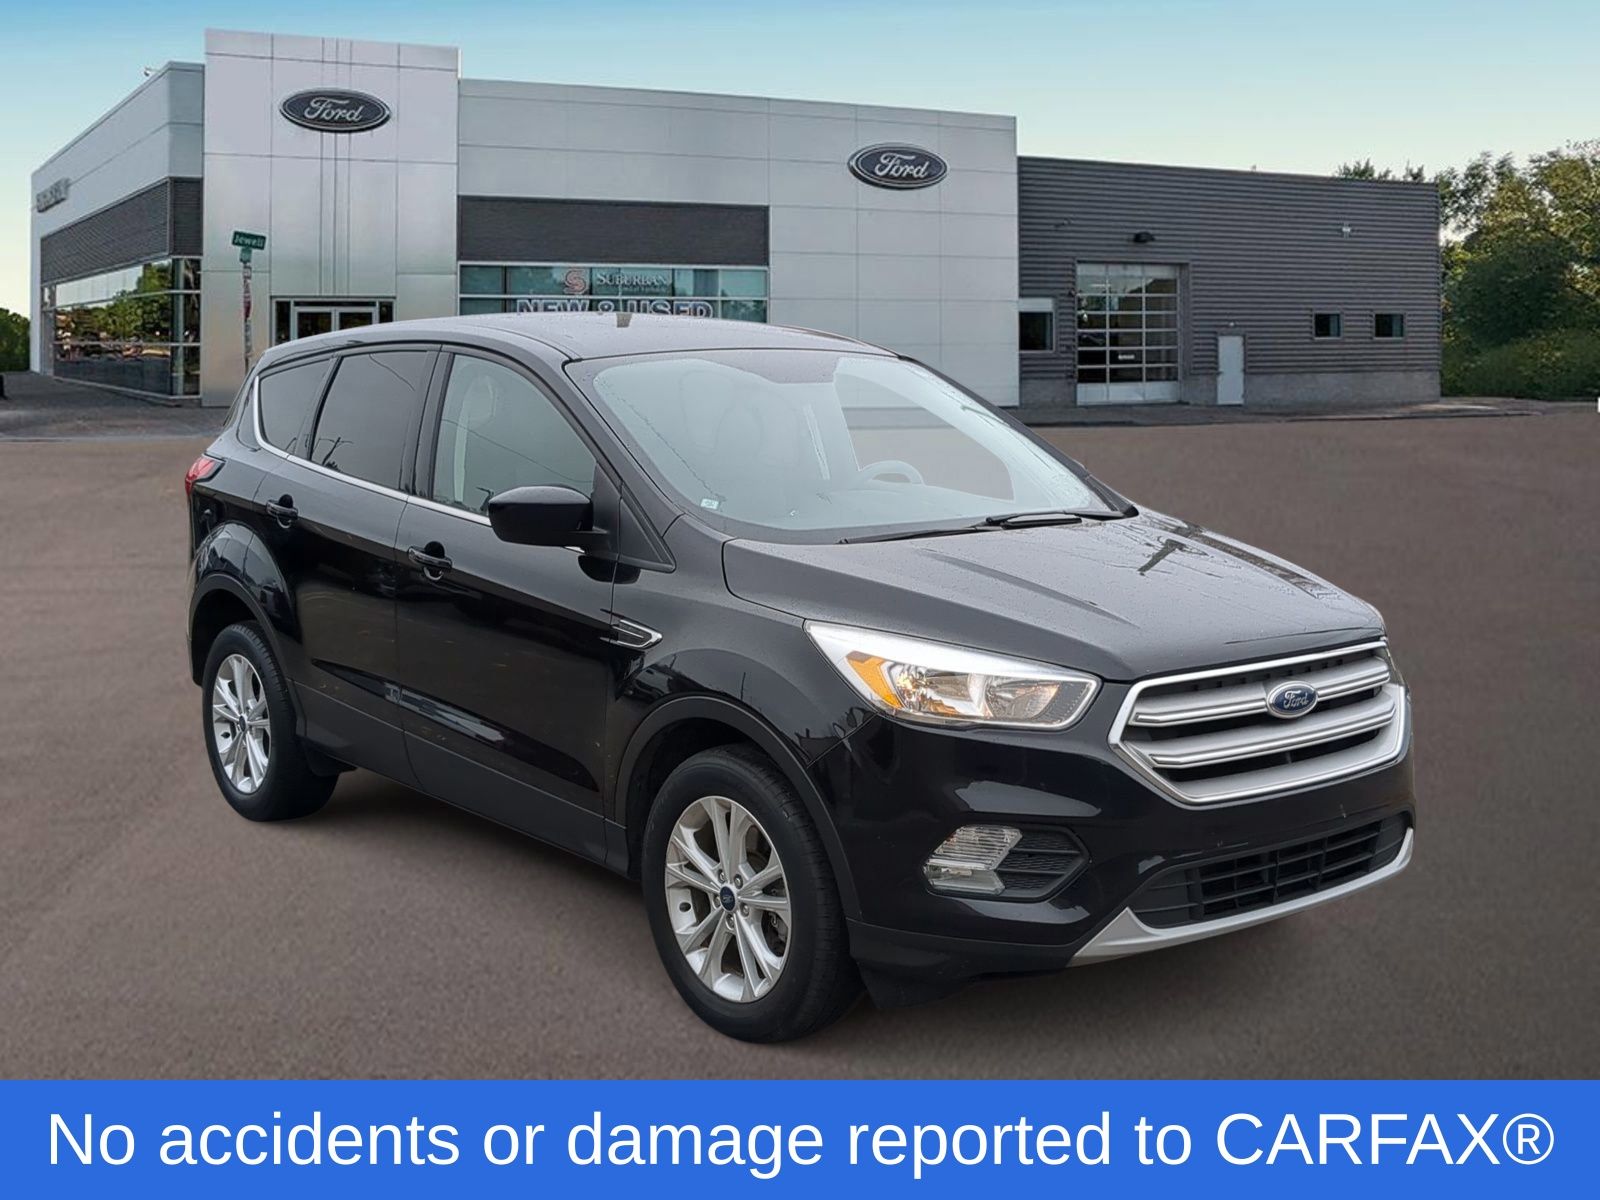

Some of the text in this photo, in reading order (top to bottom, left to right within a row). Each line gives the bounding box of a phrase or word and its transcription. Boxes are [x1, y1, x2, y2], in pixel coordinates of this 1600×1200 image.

[304, 97, 365, 121] Ford
[874, 153, 929, 178] Ford
[1283, 690, 1309, 709] Ford
